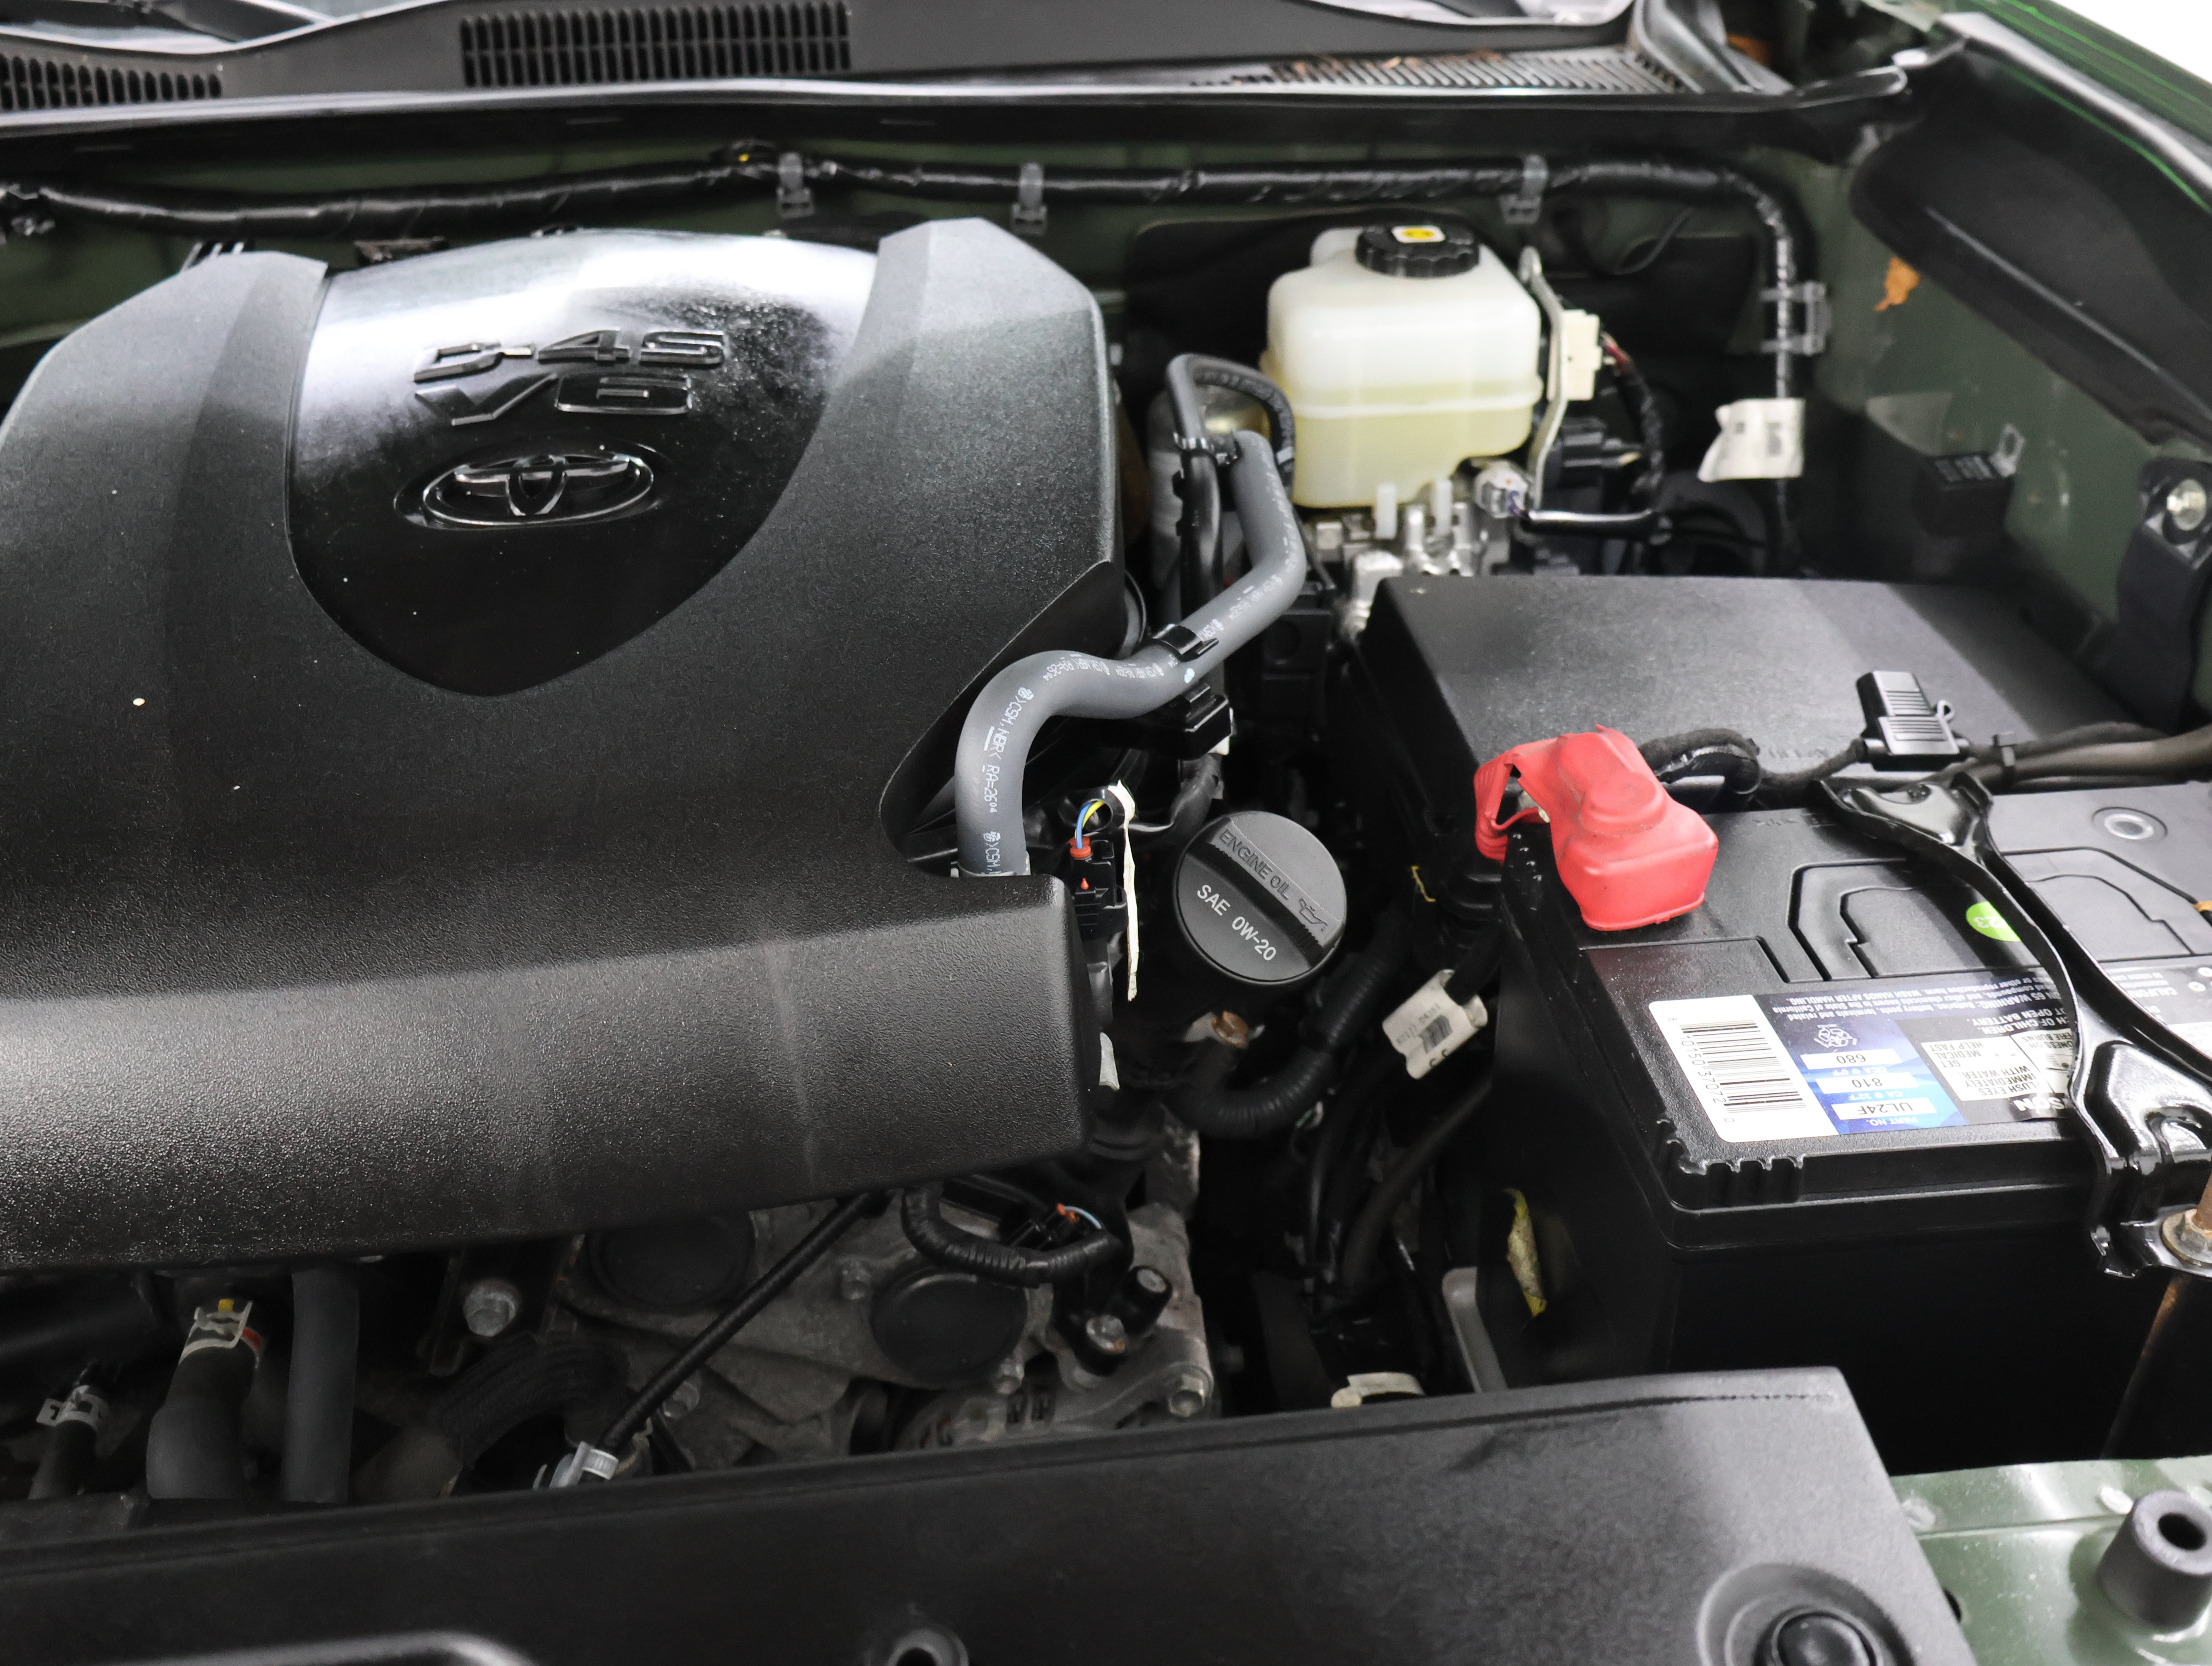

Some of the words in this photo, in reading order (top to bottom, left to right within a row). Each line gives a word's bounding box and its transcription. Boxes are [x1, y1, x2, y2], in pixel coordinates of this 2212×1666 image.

[413, 329, 724, 383] D-4S
[414, 372, 692, 426] V6
[1219, 829, 1273, 880] ENGINE
[1271, 875, 1292, 900] OIL
[1197, 885, 1231, 916] SAE
[1232, 916, 1276, 961] 0W-20
[1835, 993, 1863, 1002] AFTER
[1863, 992, 1895, 1001] HANDS
[1893, 990, 1922, 998] WASH
[2031, 992, 2046, 1000] 65
[1786, 996, 1832, 1005] HANDLING.
[1978, 994, 2032, 1009] WARNING:
[1772, 1004, 1814, 1014] California
[2021, 1008, 2053, 1018] OPEN
[1787, 1012, 1818, 1021] related
[1966, 1013, 2021, 1026] BATTERY.
[1977, 1018, 2040, 1034] CHILDREN.
[2039, 1018, 2055, 1026] OF
[2021, 1032, 2054, 1042] BURNS
[1679, 1035, 1705, 1065] 10150
[1934, 1049, 1981, 1060] MEDICAL
[1836, 1054, 1866, 1064] 680
[1941, 1060, 1961, 1068] GET
[1959, 1069, 1999, 1079] WATER.
[2001, 1065, 2030, 1075] WITH
[1851, 1078, 1883, 1088] 810
[1966, 1073, 2037, 1088] IMMEDIATELY
[1698, 1071, 1726, 1103] 37072
[1978, 1088, 2006, 1096] EYES
[1885, 1090, 1903, 1098] CA
[1857, 1102, 1913, 1115] UL24F
[1866, 1117, 1887, 1126] NO.
[1890, 1116, 1919, 1125] PART
